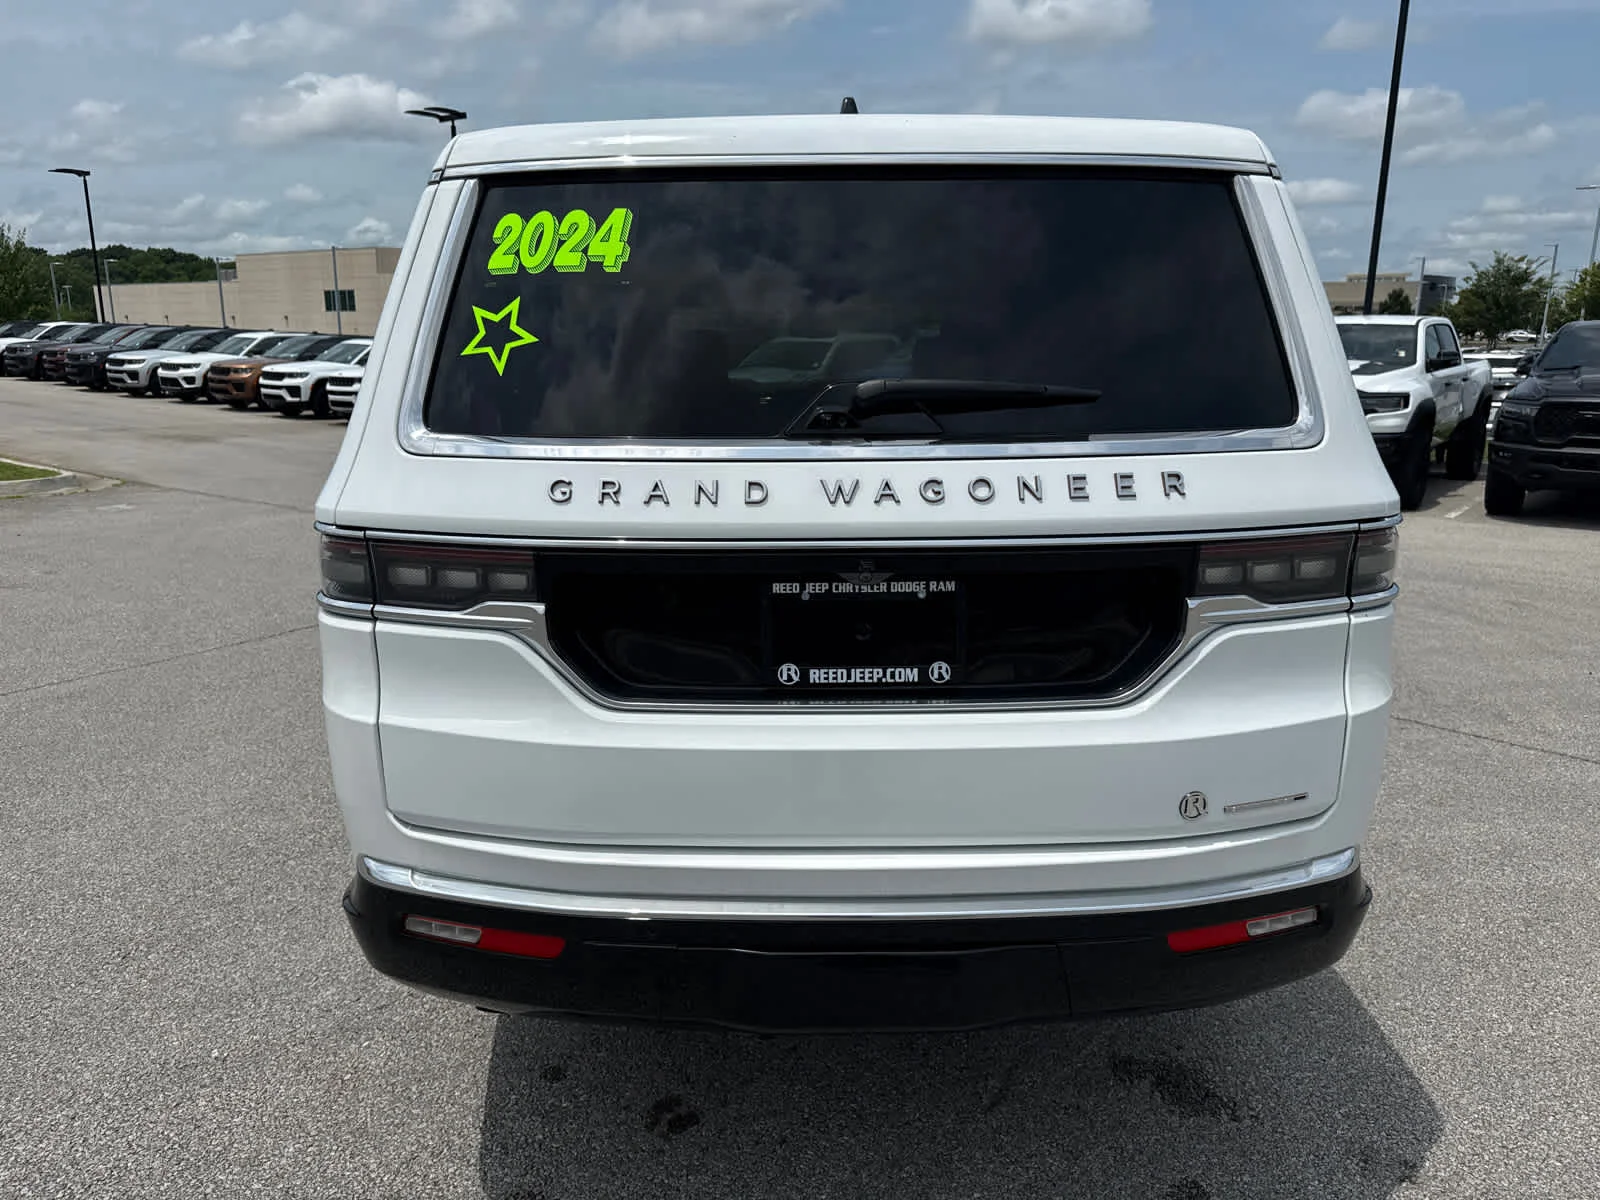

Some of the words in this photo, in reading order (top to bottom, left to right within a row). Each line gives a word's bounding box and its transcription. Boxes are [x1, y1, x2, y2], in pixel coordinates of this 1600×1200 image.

[487, 207, 633, 275] 2024
[548, 478, 769, 505] GRAND
[819, 470, 1188, 505] WAGONEER
[772, 583, 800, 594] REED
[803, 583, 829, 594] JEEP
[832, 582, 887, 593] CHRYSLER
[890, 581, 927, 592] DODGE
[929, 580, 956, 592] RAM
[809, 668, 919, 683] REEDJEEP.COM
